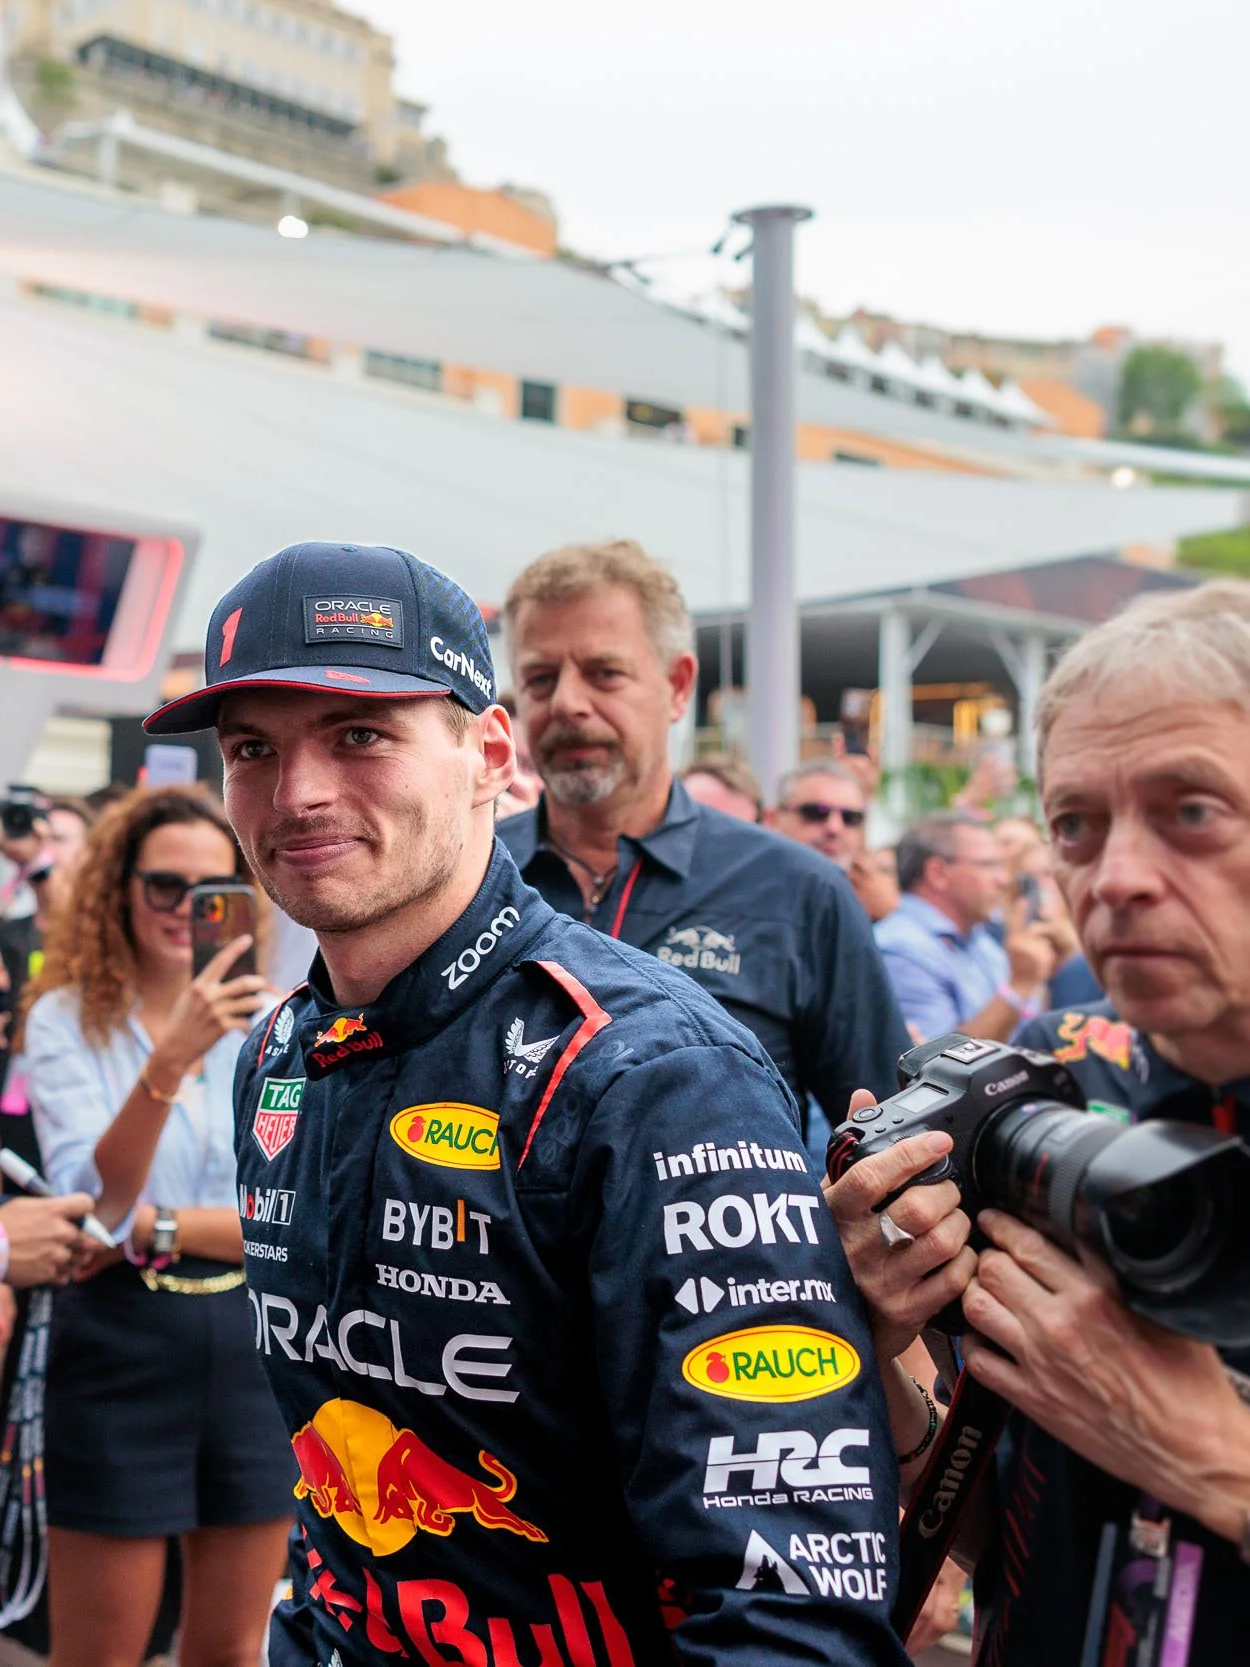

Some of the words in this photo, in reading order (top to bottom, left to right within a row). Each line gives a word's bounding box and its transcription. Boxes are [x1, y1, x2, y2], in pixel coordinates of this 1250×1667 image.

[314, 600, 392, 615] ORACLE
[315, 613, 338, 624] Red
[337, 613, 359, 624] Bull
[219, 607, 243, 668] 1
[316, 626, 394, 639] RACING
[430, 636, 493, 700] CarNext
[440, 906, 520, 990] zoom
[700, 951, 741, 976] Bull
[311, 1043, 352, 1068] Red
[349, 1031, 384, 1053] Bull
[268, 1083, 303, 1109] TAG
[984, 1069, 1030, 1097] Canon
[257, 1113, 296, 1154] HEUER
[653, 1140, 808, 1181] infinitum
[382, 1198, 491, 1255] BYBIT
[663, 1193, 820, 1255] ROKT
[375, 1263, 511, 1305] HONDA
[728, 1276, 837, 1307] inter.mx
[733, 1347, 838, 1381] RAUCH
[703, 1428, 870, 1495] HRC
[702, 1492, 789, 1509] Honda
[793, 1487, 874, 1504] RACING
[918, 1425, 982, 1540] Canon
[788, 1531, 887, 1566] ARCTIC
[809, 1567, 887, 1601] WOLF
